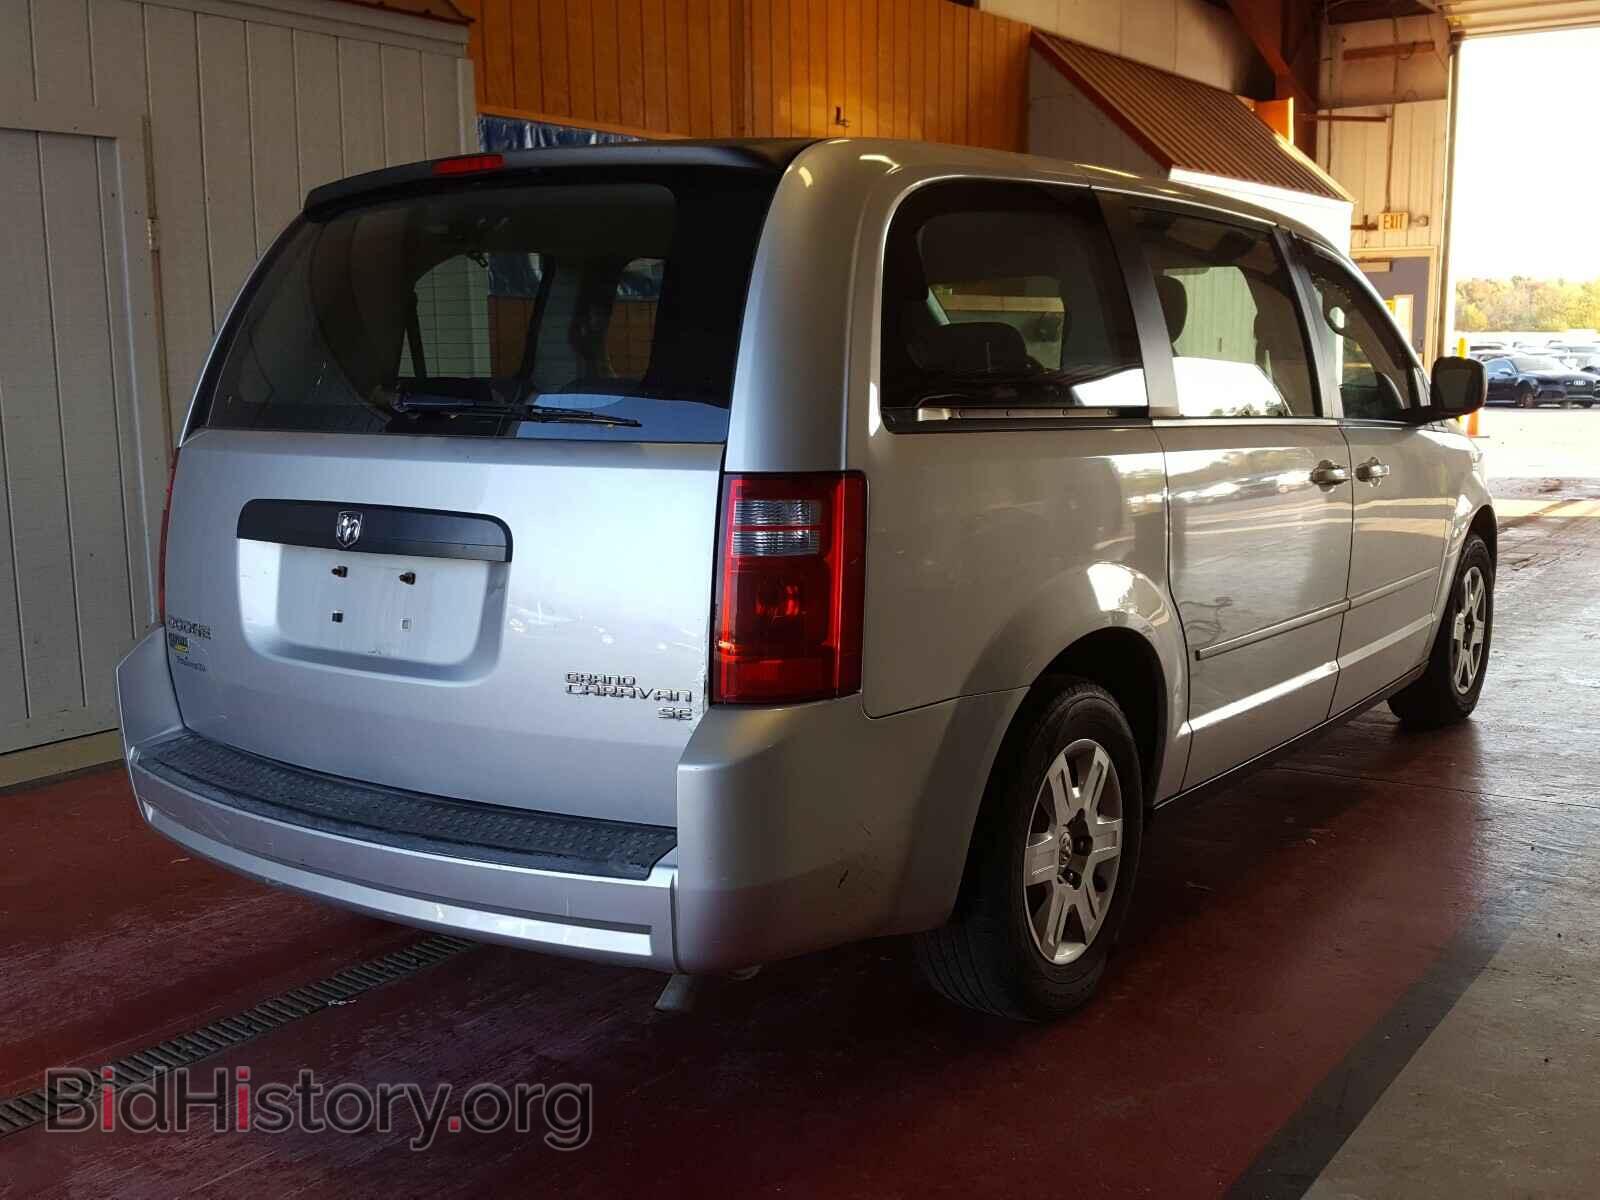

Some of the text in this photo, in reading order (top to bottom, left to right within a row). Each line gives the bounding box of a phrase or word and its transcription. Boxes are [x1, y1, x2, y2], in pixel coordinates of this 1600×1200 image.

[1383, 214, 1405, 230] EXIT
[566, 671, 636, 686] GRAND
[566, 682, 693, 703] CARAVAN
[657, 706, 693, 721] SE
